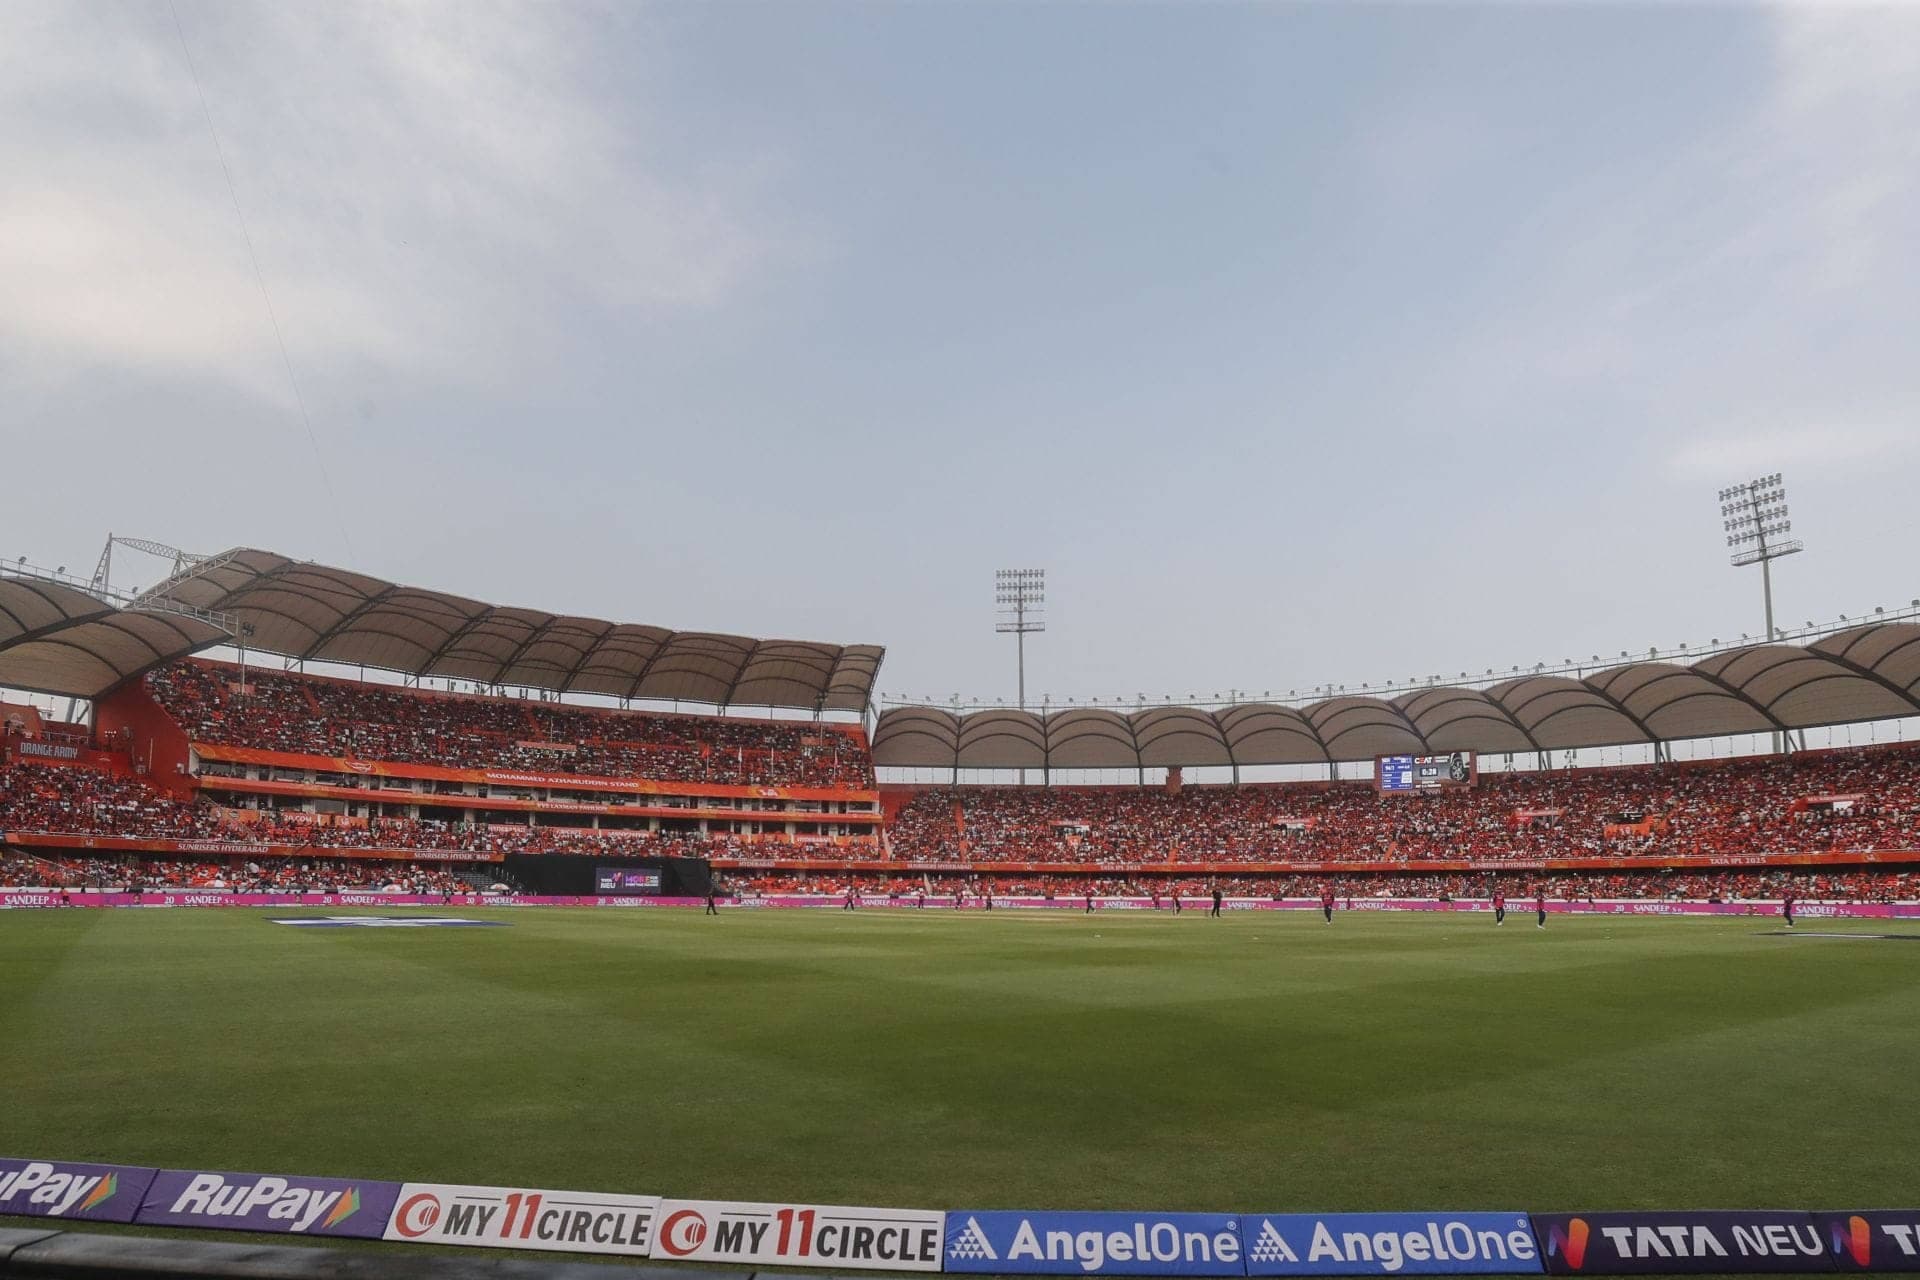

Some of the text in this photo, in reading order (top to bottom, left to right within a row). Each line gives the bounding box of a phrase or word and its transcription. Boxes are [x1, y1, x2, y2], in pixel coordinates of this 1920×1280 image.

[20, 742, 78, 759] ORANGE ARMY
[486, 772, 639, 789] MOHAMMED AZHARUDDIN STAND
[178, 843, 269, 854] SUNRISERS HYDERABAD
[414, 852, 490, 861] SUNRISERS HYDERBAD
[1505, 861, 1546, 869] HYDERABAD
[1709, 857, 1768, 866] TATA IPL 2025
[4, 895, 49, 905] SANDEEP
[164, 896, 175, 905] 20
[184, 896, 223, 904] SANDEEP
[322, 896, 332, 904] 20
[341, 896, 376, 904] SANDEEP
[466, 896, 475, 905] 20
[482, 896, 514, 905] SANDEEP
[613, 897, 644, 905] SANDEEP
[1615, 904, 1625, 912] 20
[1633, 904, 1670, 912] SANDEEP
[1795, 905, 1837, 915] SANDEEP
[169, 1174, 344, 1232] RuPay
[1601, 1224, 1825, 1258] TATA NEU
[1881, 1224, 1920, 1256] T
